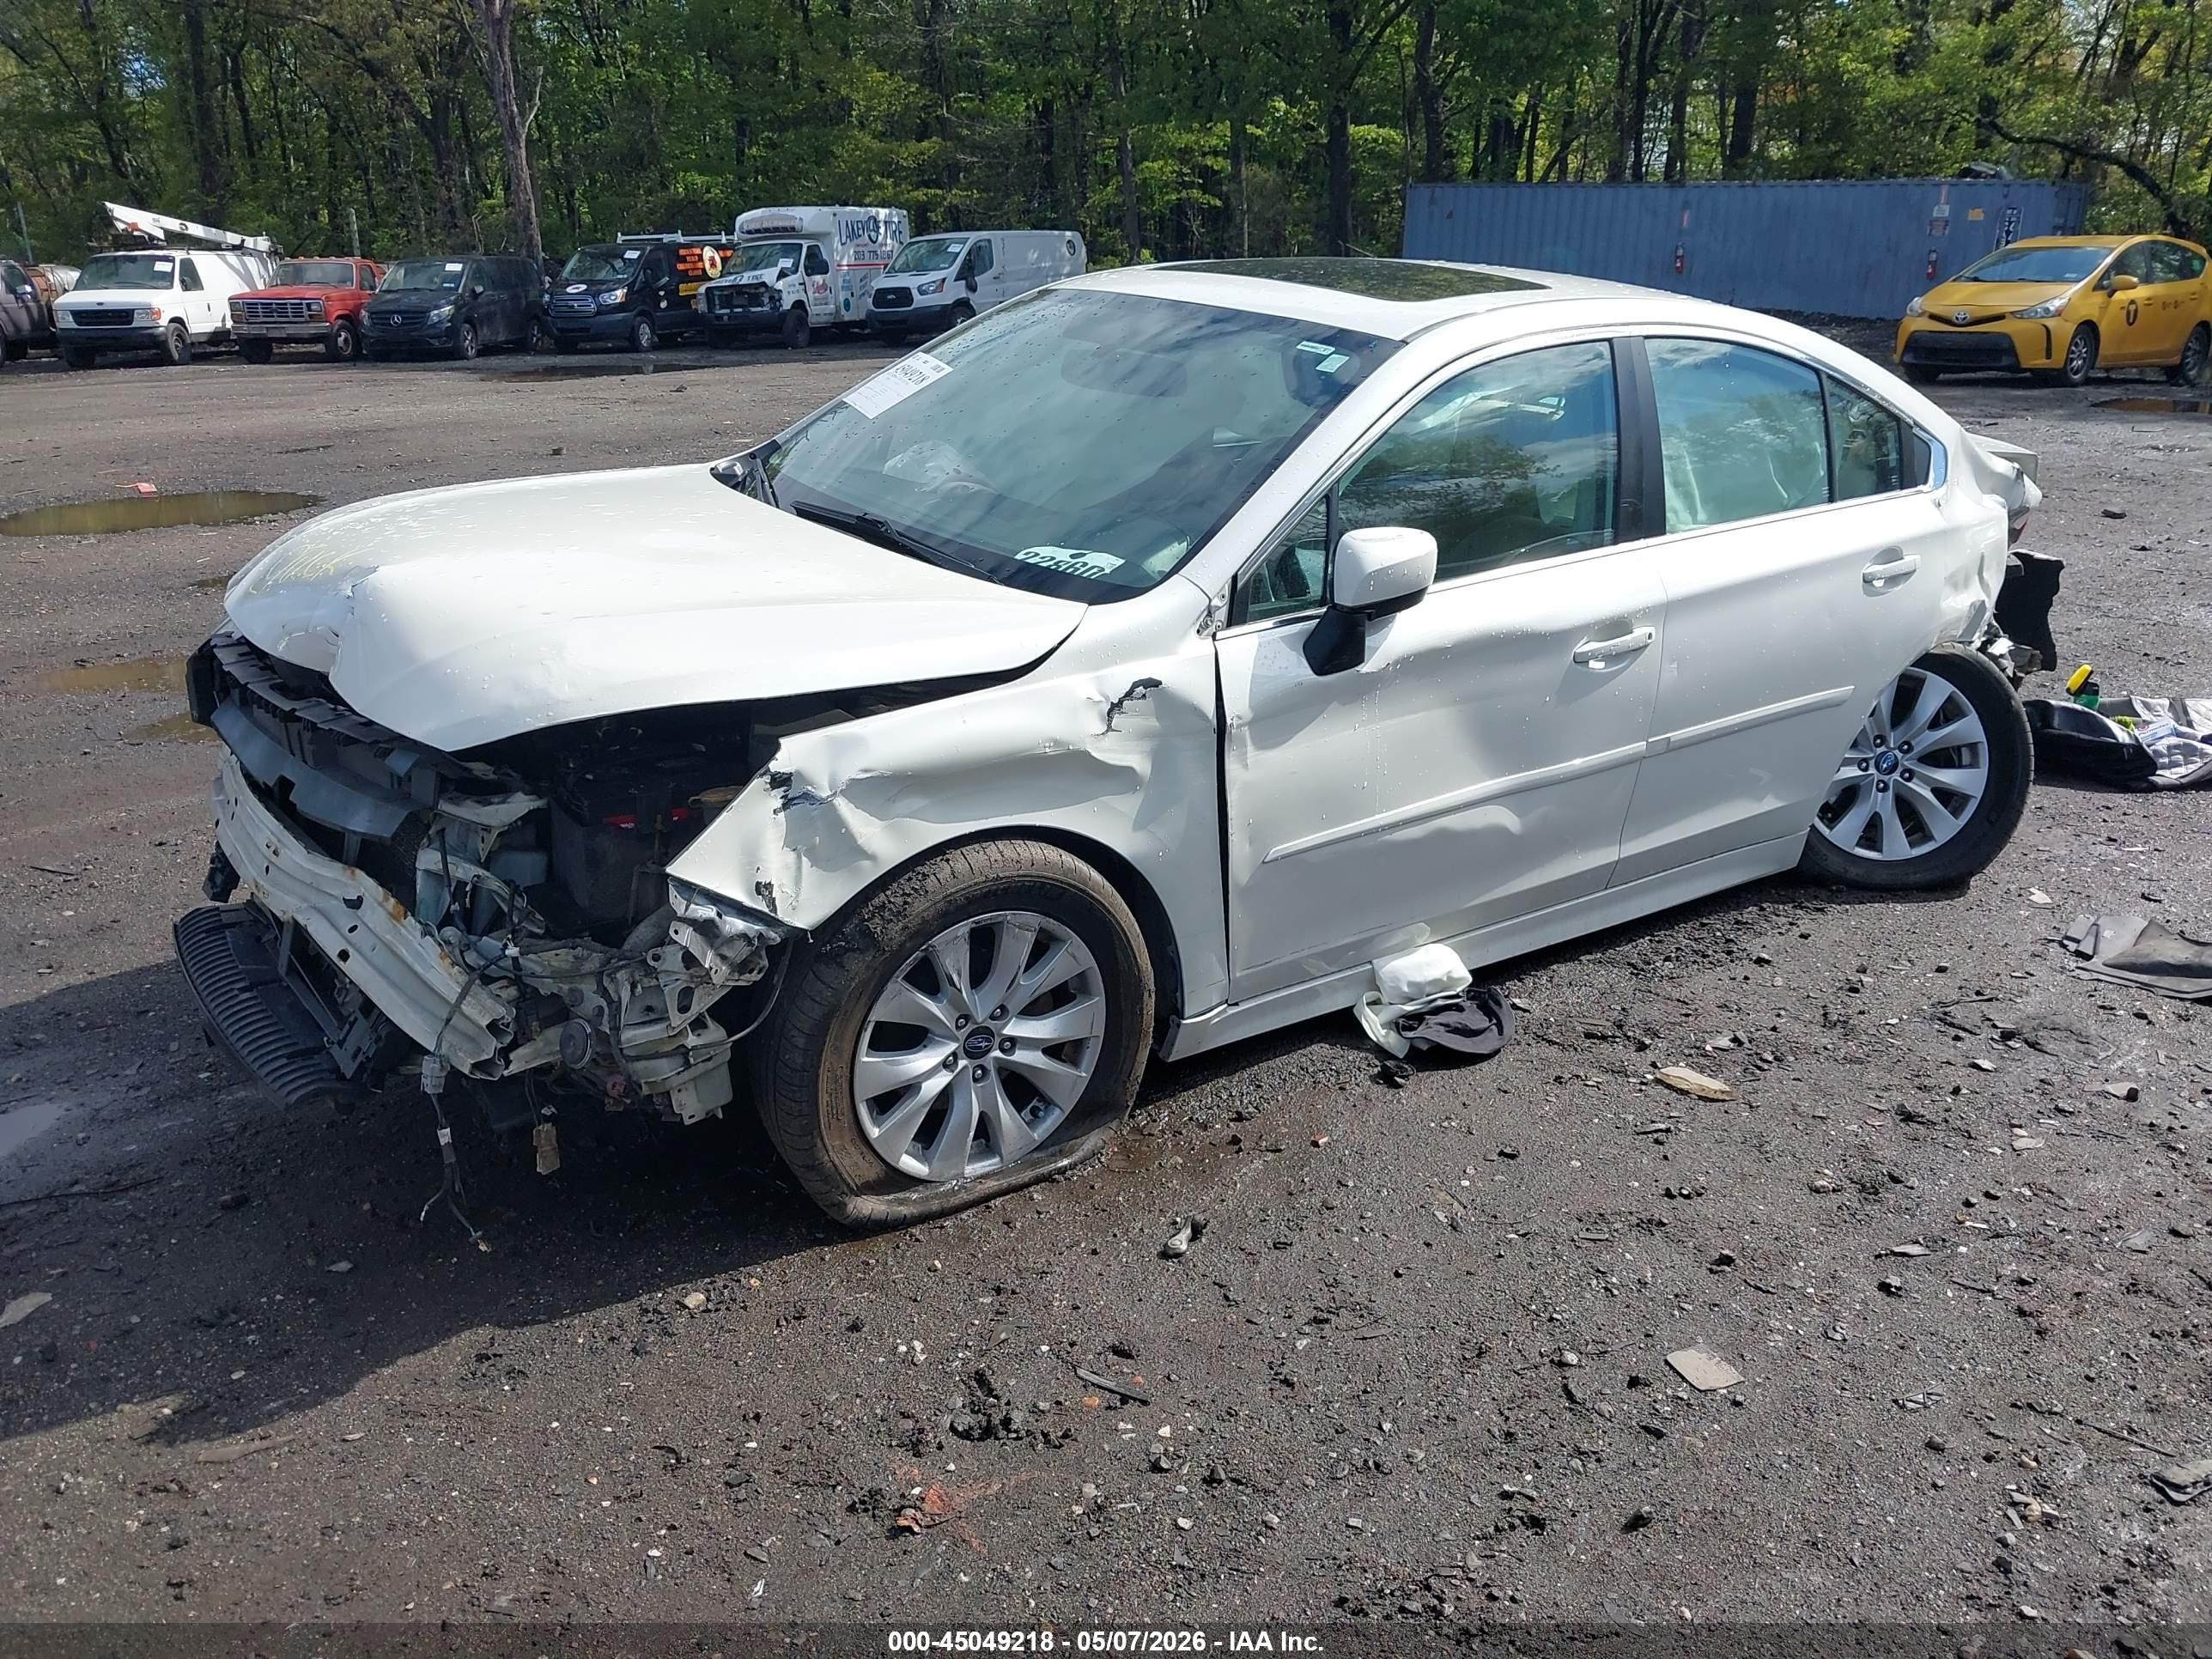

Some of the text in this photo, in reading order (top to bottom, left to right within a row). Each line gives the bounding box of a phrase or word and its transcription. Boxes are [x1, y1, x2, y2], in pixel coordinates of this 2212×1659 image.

[884, 220, 904, 246] TIRE
[854, 250, 866, 261] 203
[867, 250, 878, 260] 775
